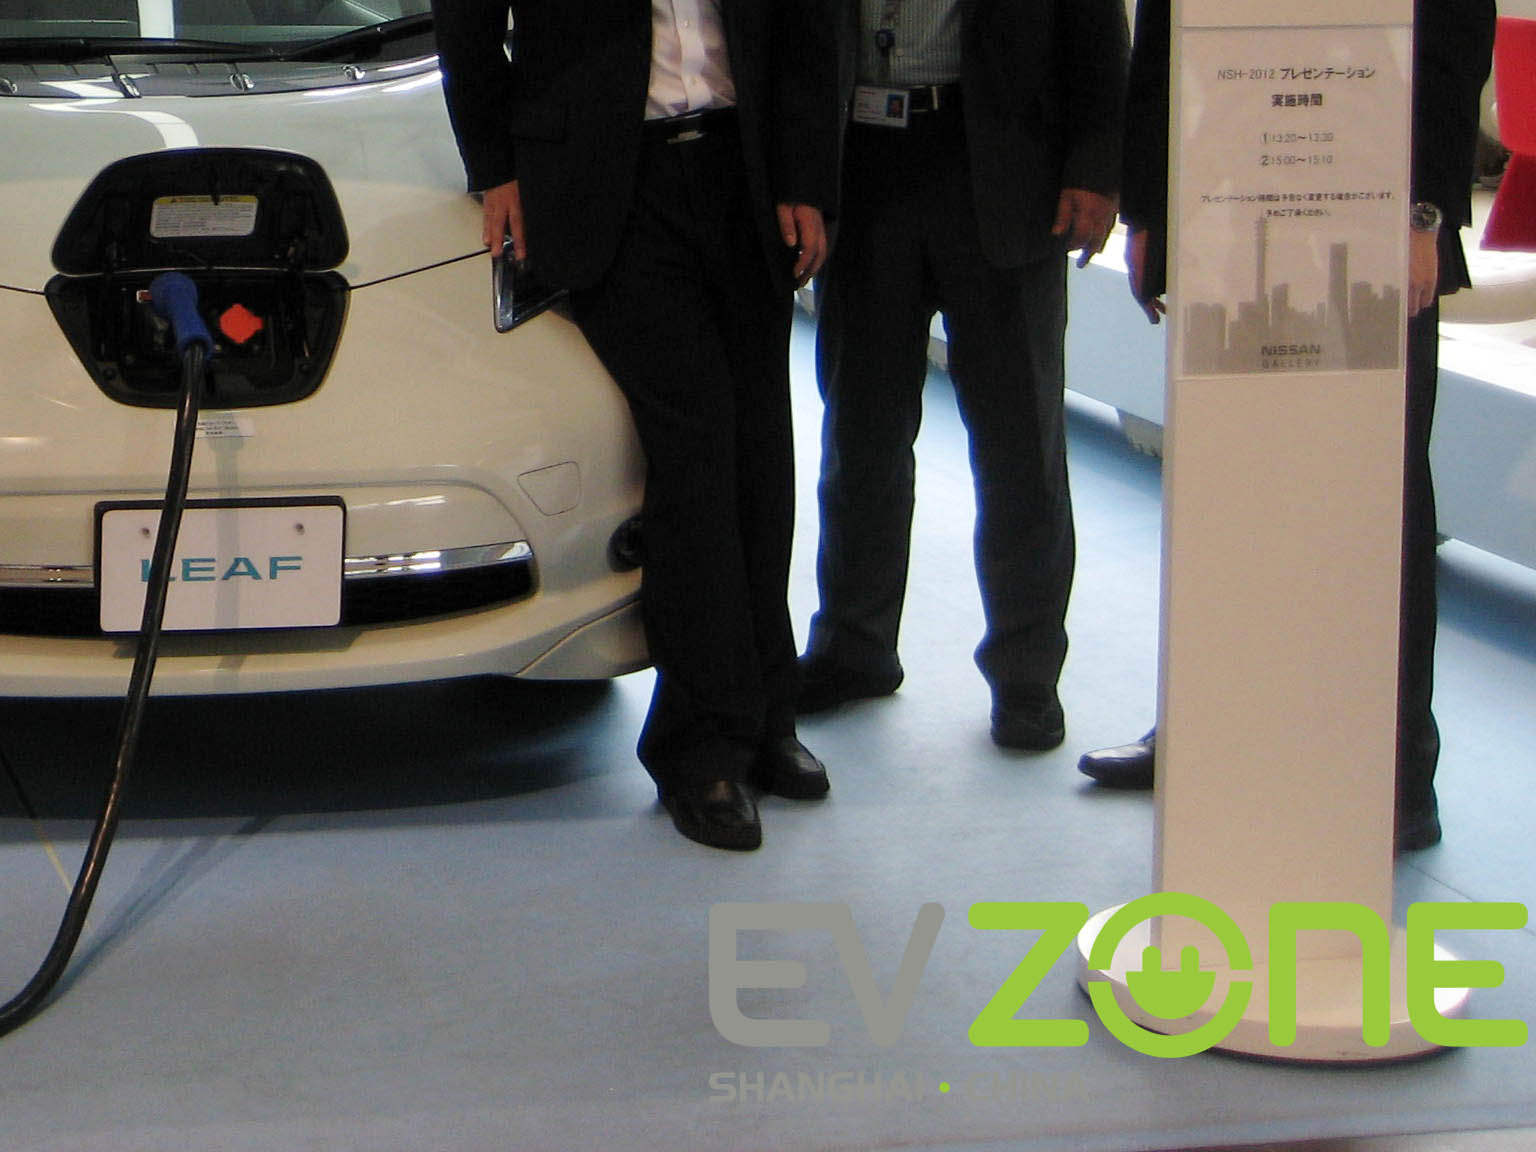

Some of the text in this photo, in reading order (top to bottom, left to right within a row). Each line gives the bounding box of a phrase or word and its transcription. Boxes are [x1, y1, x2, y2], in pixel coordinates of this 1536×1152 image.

[1217, 66, 1376, 81] NSH-2012 プレゼンテーション
[1271, 93, 1324, 108] 実施時間
[1261, 344, 1321, 356] NISSAN
